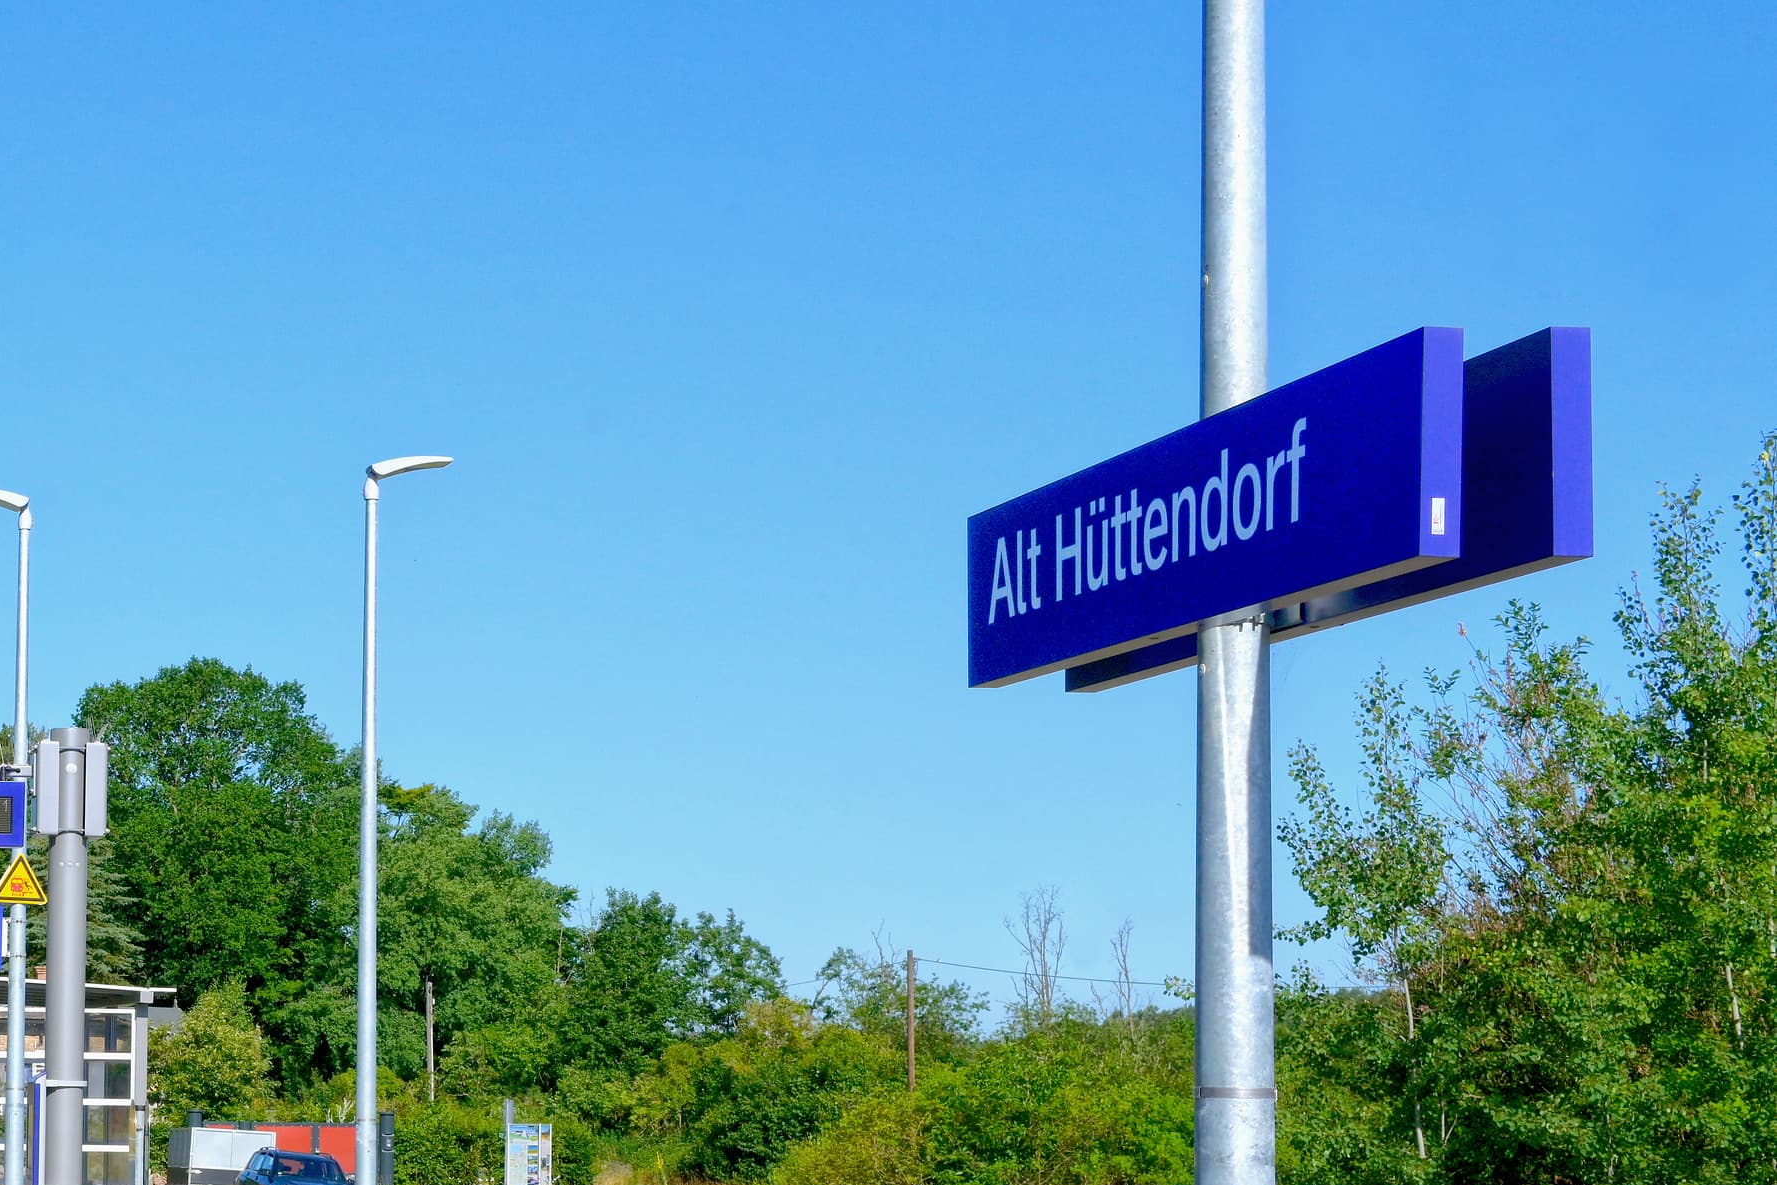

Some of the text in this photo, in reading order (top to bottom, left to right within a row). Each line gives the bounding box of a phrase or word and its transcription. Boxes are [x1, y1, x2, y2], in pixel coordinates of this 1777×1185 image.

[988, 417, 1307, 625] Alt Hüttendorf
[1, 799, 9, 812] 1
